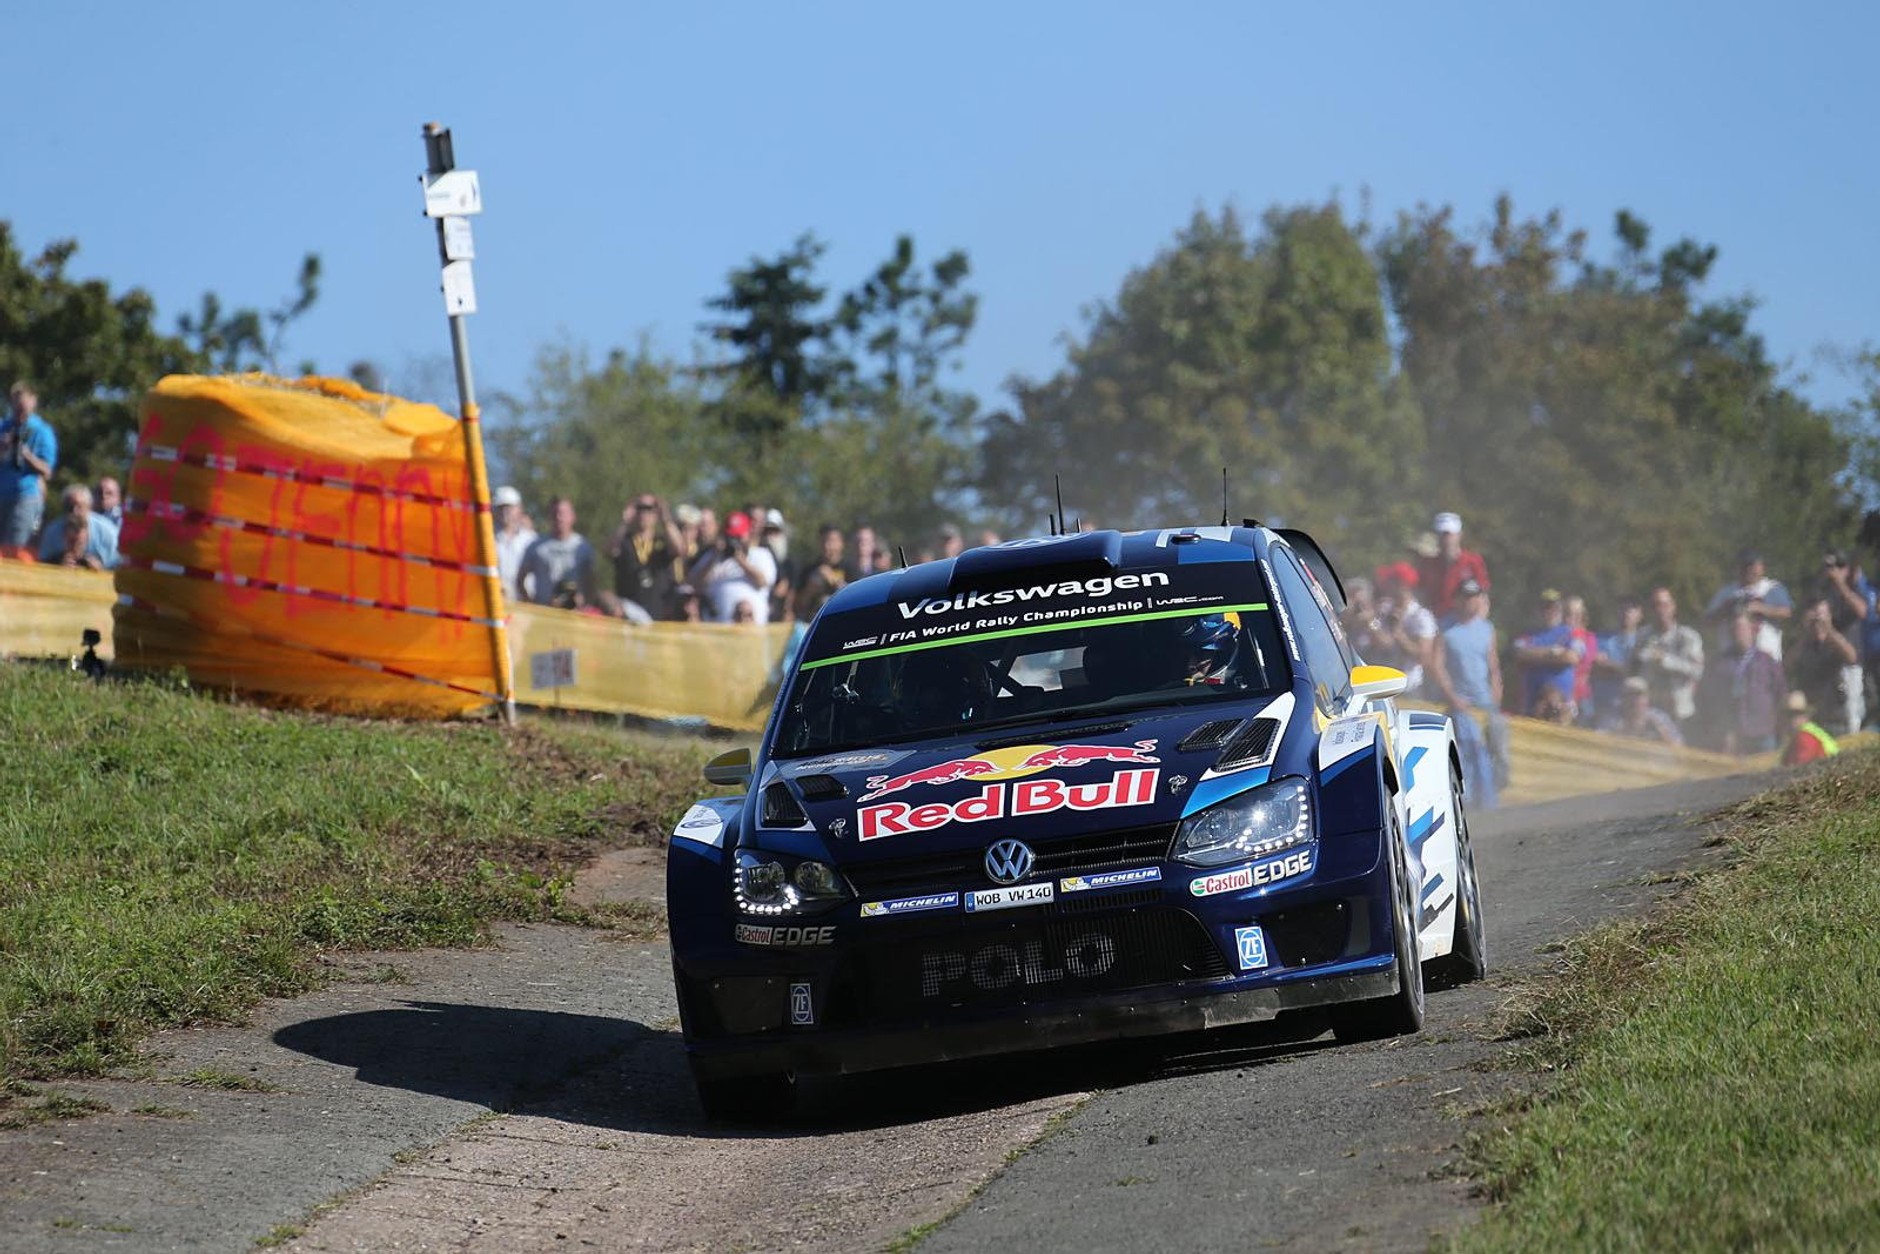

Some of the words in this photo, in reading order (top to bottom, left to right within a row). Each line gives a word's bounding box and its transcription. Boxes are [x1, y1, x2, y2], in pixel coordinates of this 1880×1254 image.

[898, 572, 1169, 619] Volkswagen
[889, 630, 917, 643] FIA
[922, 621, 970, 637] World
[976, 615, 1018, 629] Rally
[1023, 600, 1143, 622] Championship
[859, 785, 1003, 840] Red
[1014, 770, 1157, 815] Bull
[1091, 869, 1159, 885] MICHELIN
[1206, 871, 1250, 893] Castrol
[1253, 850, 1313, 886] EDGE
[890, 894, 956, 911] MICHELIN
[976, 893, 1001, 906] WOB
[1027, 887, 1052, 900] 140
[742, 926, 770, 944] Castrol
[772, 926, 837, 945] EDGE
[922, 933, 1115, 997] POLO
